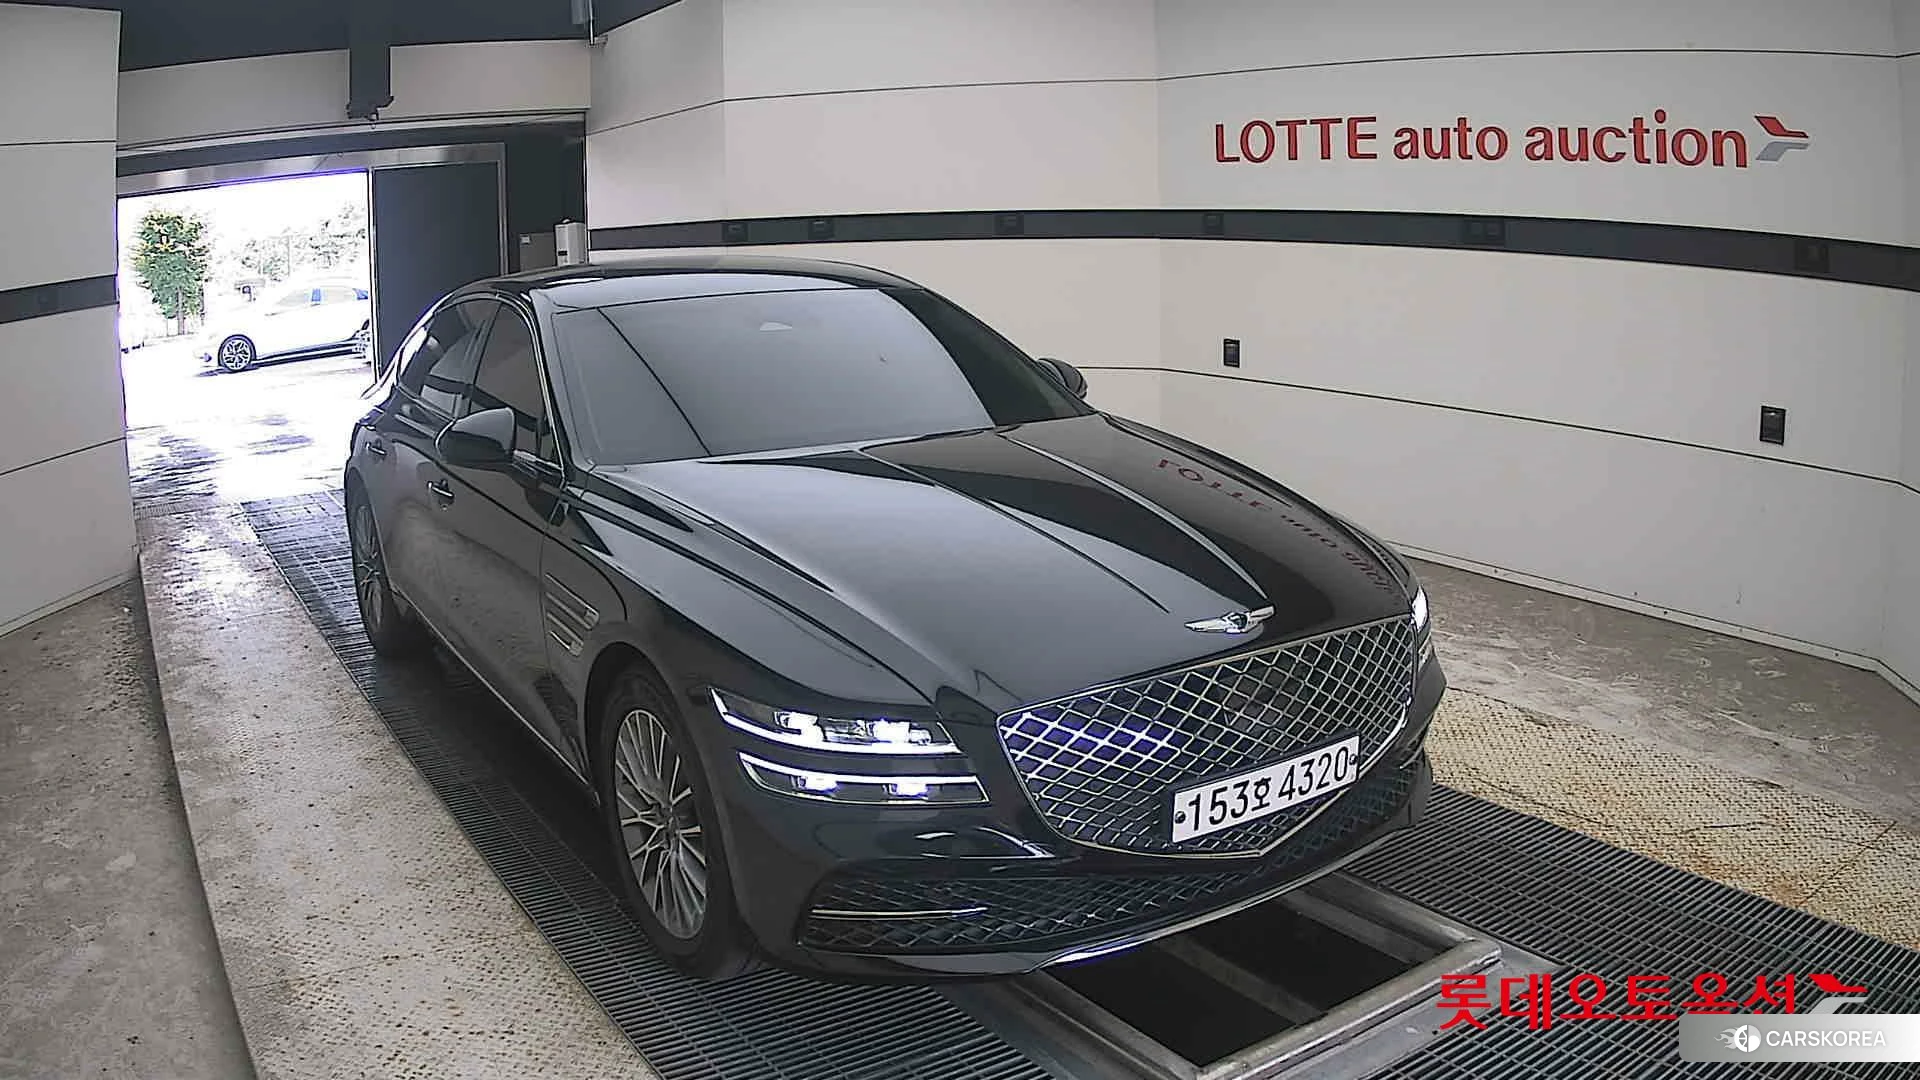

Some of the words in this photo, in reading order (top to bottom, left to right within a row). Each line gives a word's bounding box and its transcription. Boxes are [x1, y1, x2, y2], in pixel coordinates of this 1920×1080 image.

[1214, 116, 1377, 163] LOTTE
[1393, 117, 1509, 161] auto
[1524, 109, 1748, 168] auction
[1188, 776, 1272, 832] 153호
[1277, 745, 1350, 801] 4320
